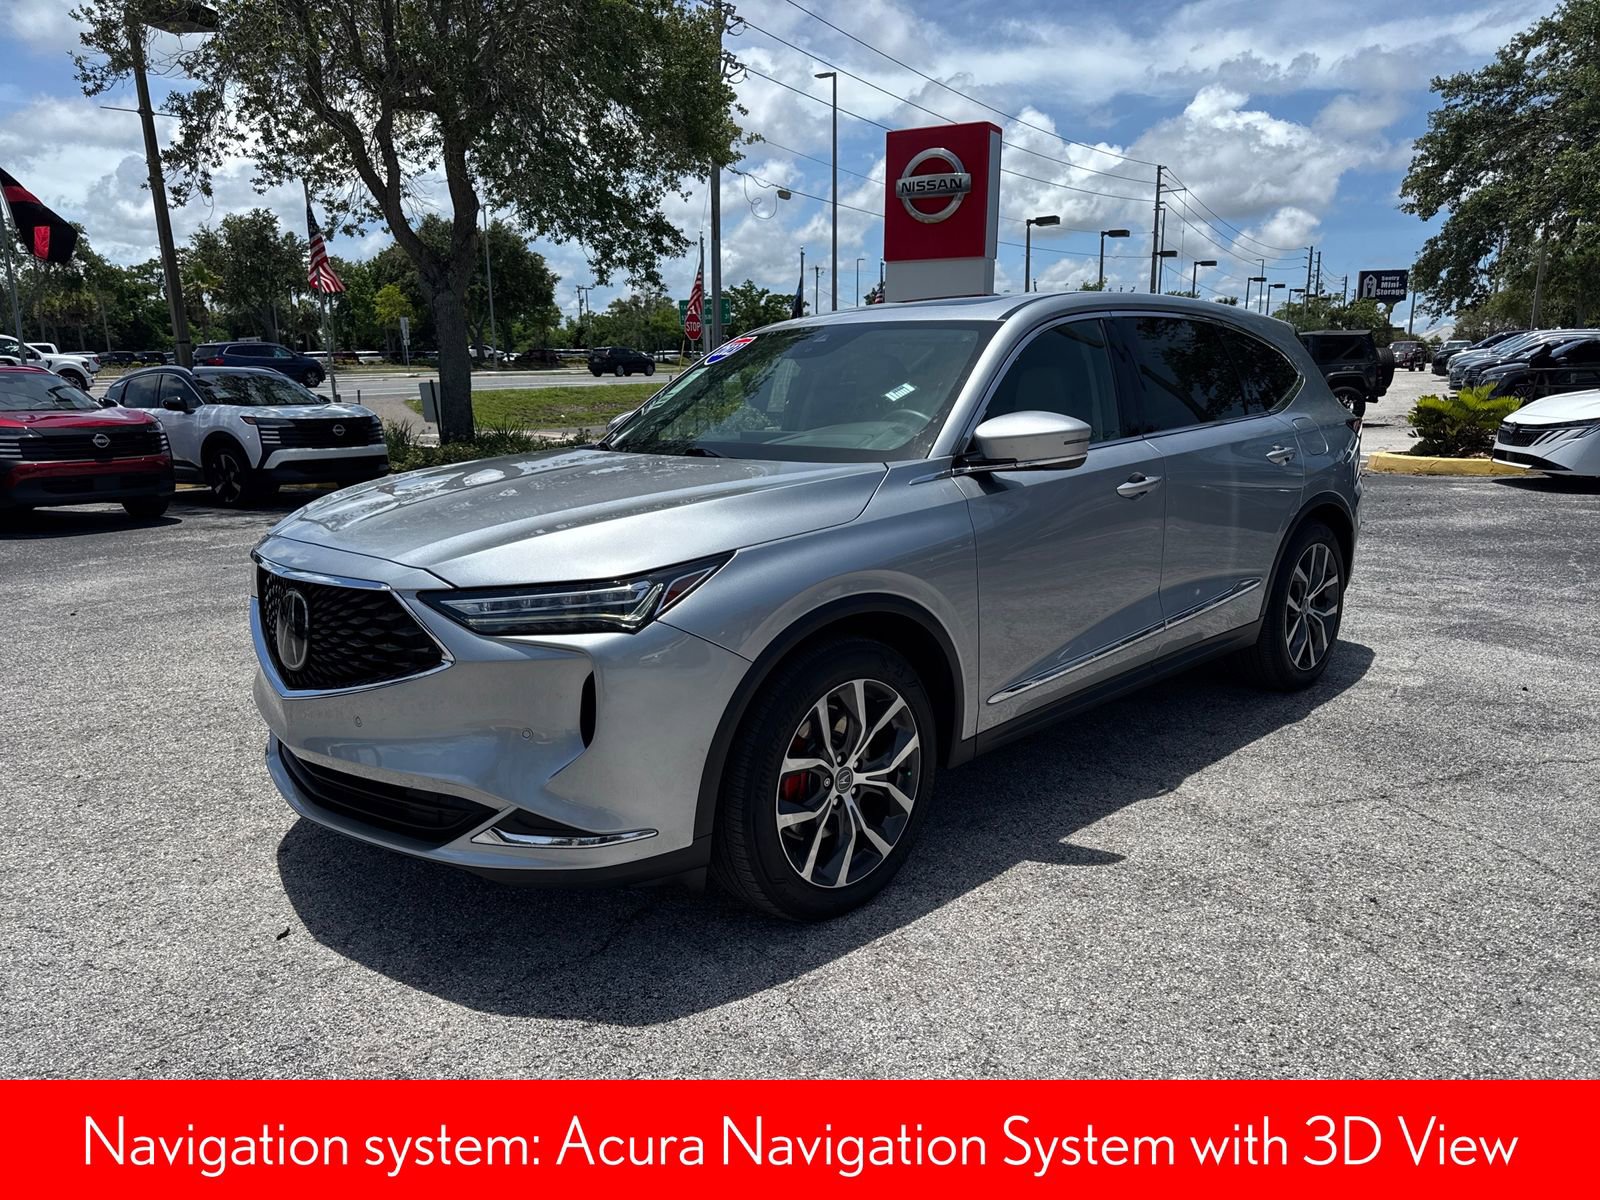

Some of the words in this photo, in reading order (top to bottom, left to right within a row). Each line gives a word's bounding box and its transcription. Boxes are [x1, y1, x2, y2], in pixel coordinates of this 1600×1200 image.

[901, 178, 962, 193] NISSAN
[1376, 288, 1405, 296] Storage
[686, 321, 701, 332] STOP
